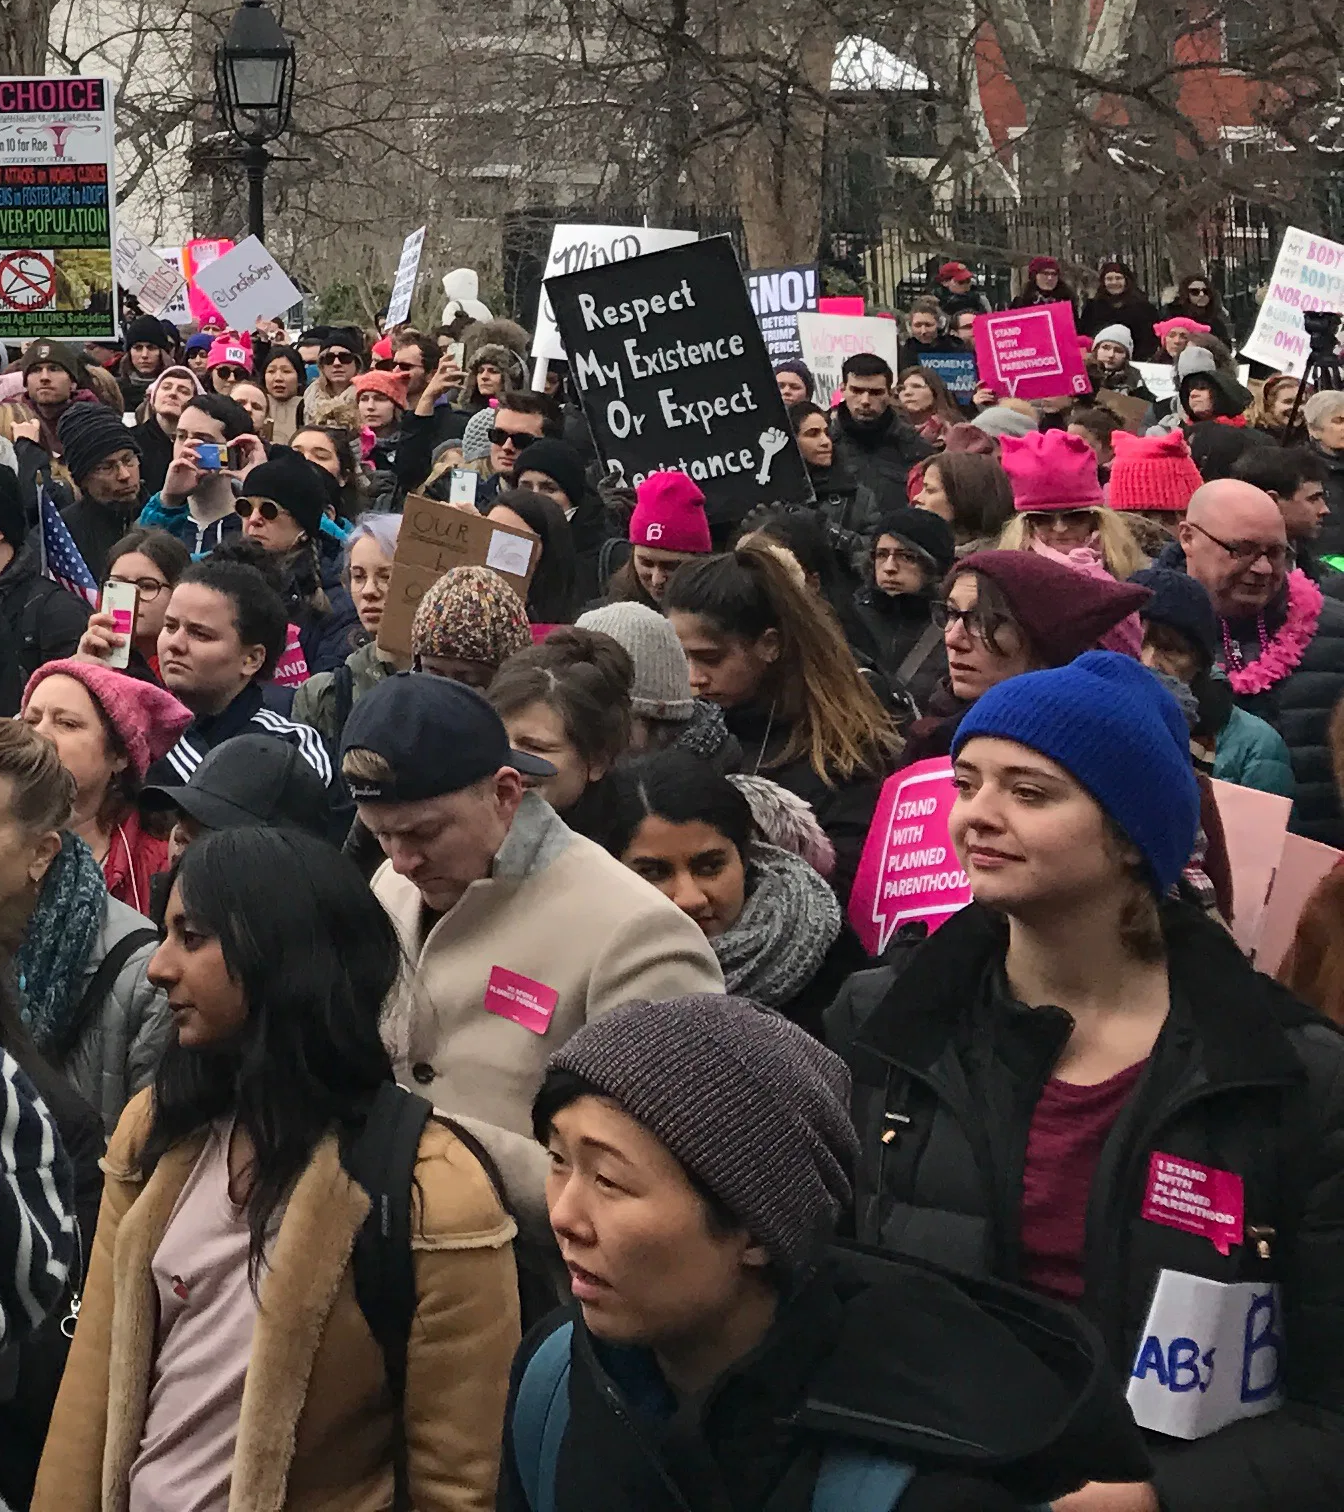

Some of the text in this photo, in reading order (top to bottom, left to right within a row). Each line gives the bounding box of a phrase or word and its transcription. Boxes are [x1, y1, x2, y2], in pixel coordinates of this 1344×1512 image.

[32, 138, 48, 152] Roe
[578, 279, 696, 332] Respect
[762, 328, 796, 343] TRUMP
[769, 340, 800, 355] PENCE
[1274, 330, 1305, 356] OWN
[575, 335, 745, 398] My Existence
[607, 400, 647, 439] Or
[657, 383, 758, 435] Expect
[413, 511, 469, 543] OUR
[897, 797, 938, 822] STAND
[892, 825, 924, 847] WITH
[887, 847, 947, 874] PLANNED
[883, 869, 971, 900] PARENTHOOD
[1156, 1171, 1193, 1190] WITH
[1158, 1160, 1208, 1183] I STAND
